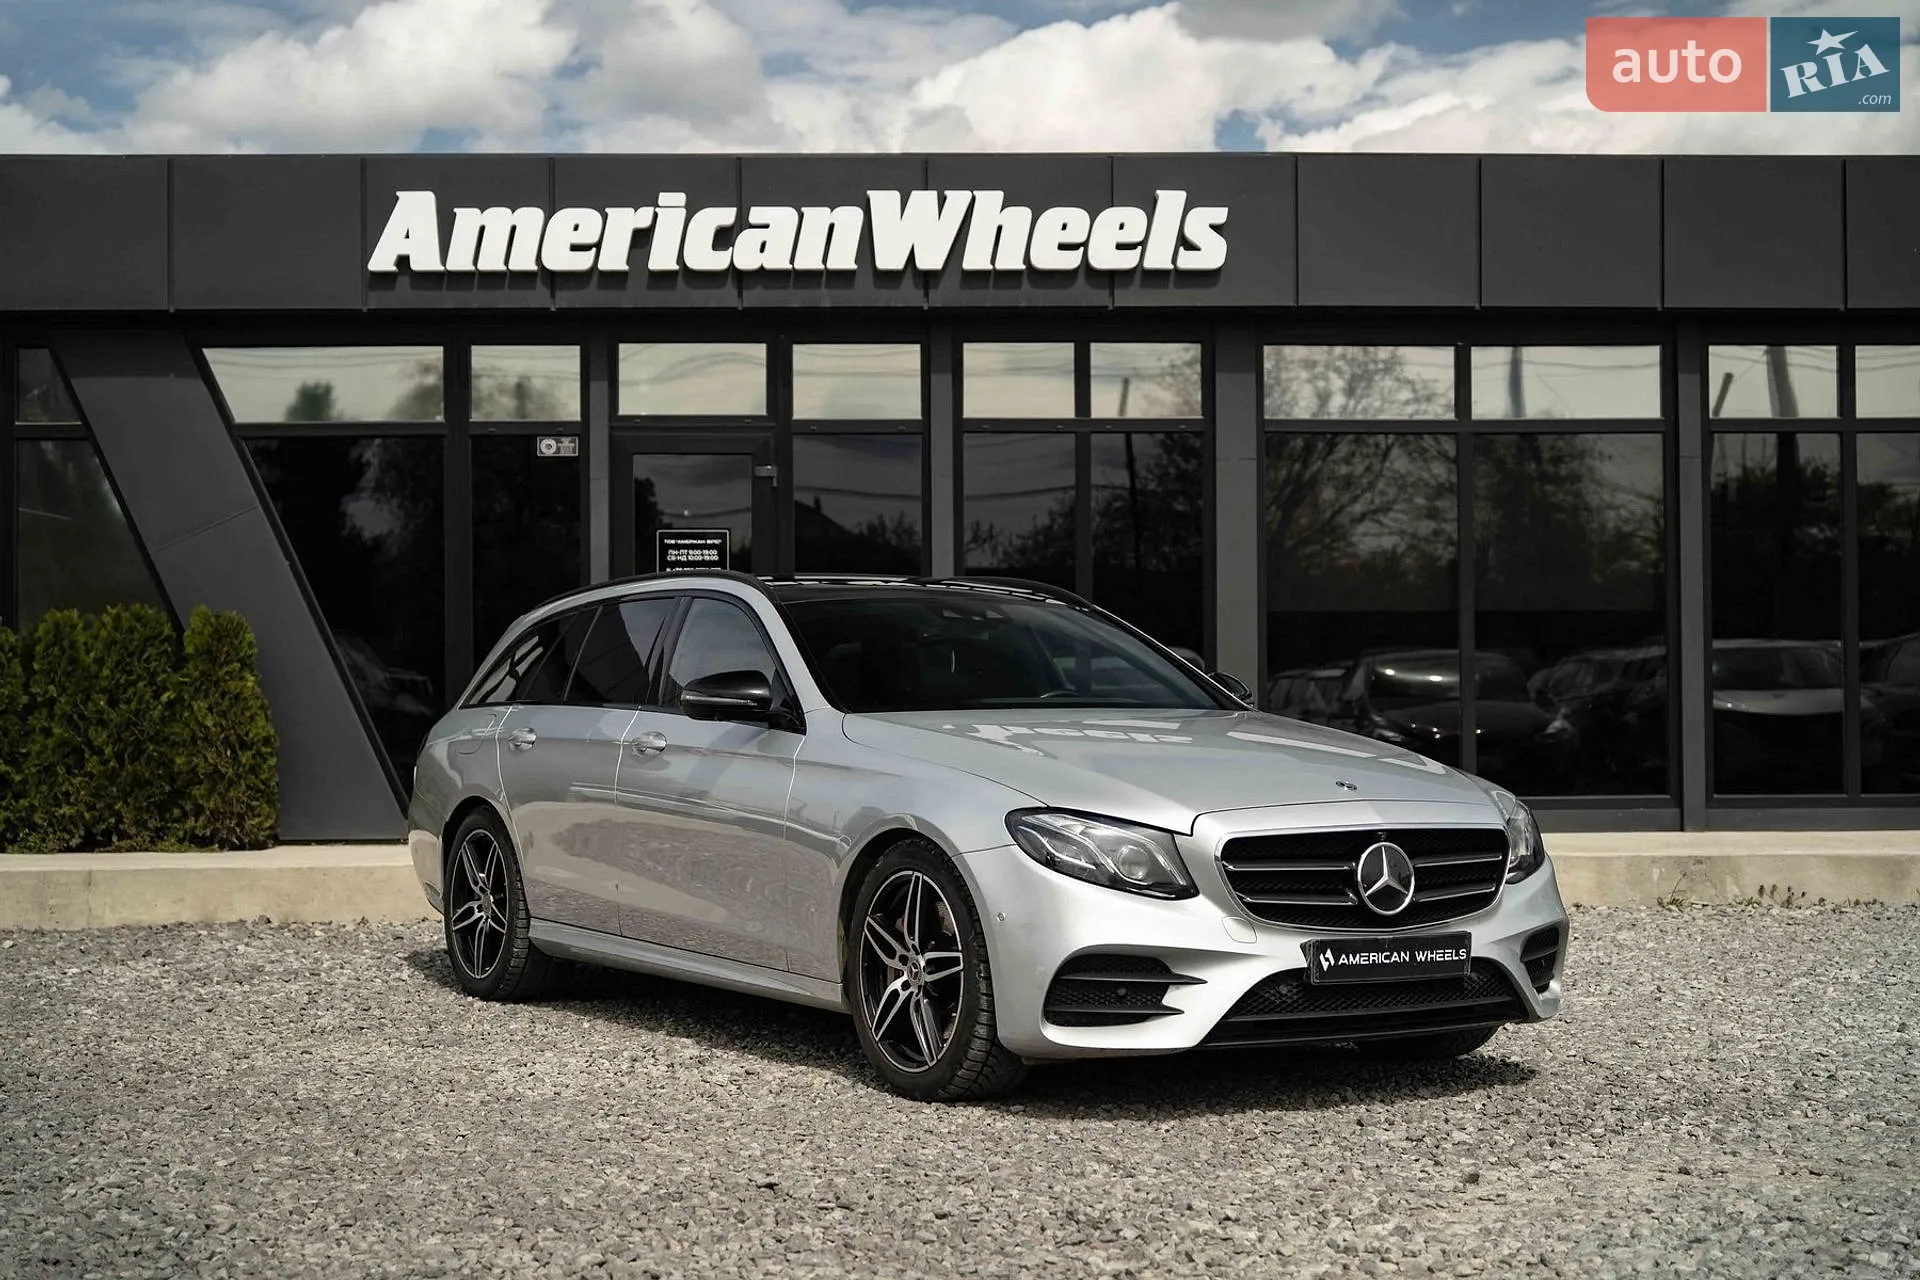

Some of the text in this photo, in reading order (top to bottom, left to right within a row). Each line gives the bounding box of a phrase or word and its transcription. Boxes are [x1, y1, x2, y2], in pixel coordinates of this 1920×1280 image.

[366, 189, 1229, 272] AmericanWheels
[1338, 949, 1467, 965] AMERICAN WHEELS
